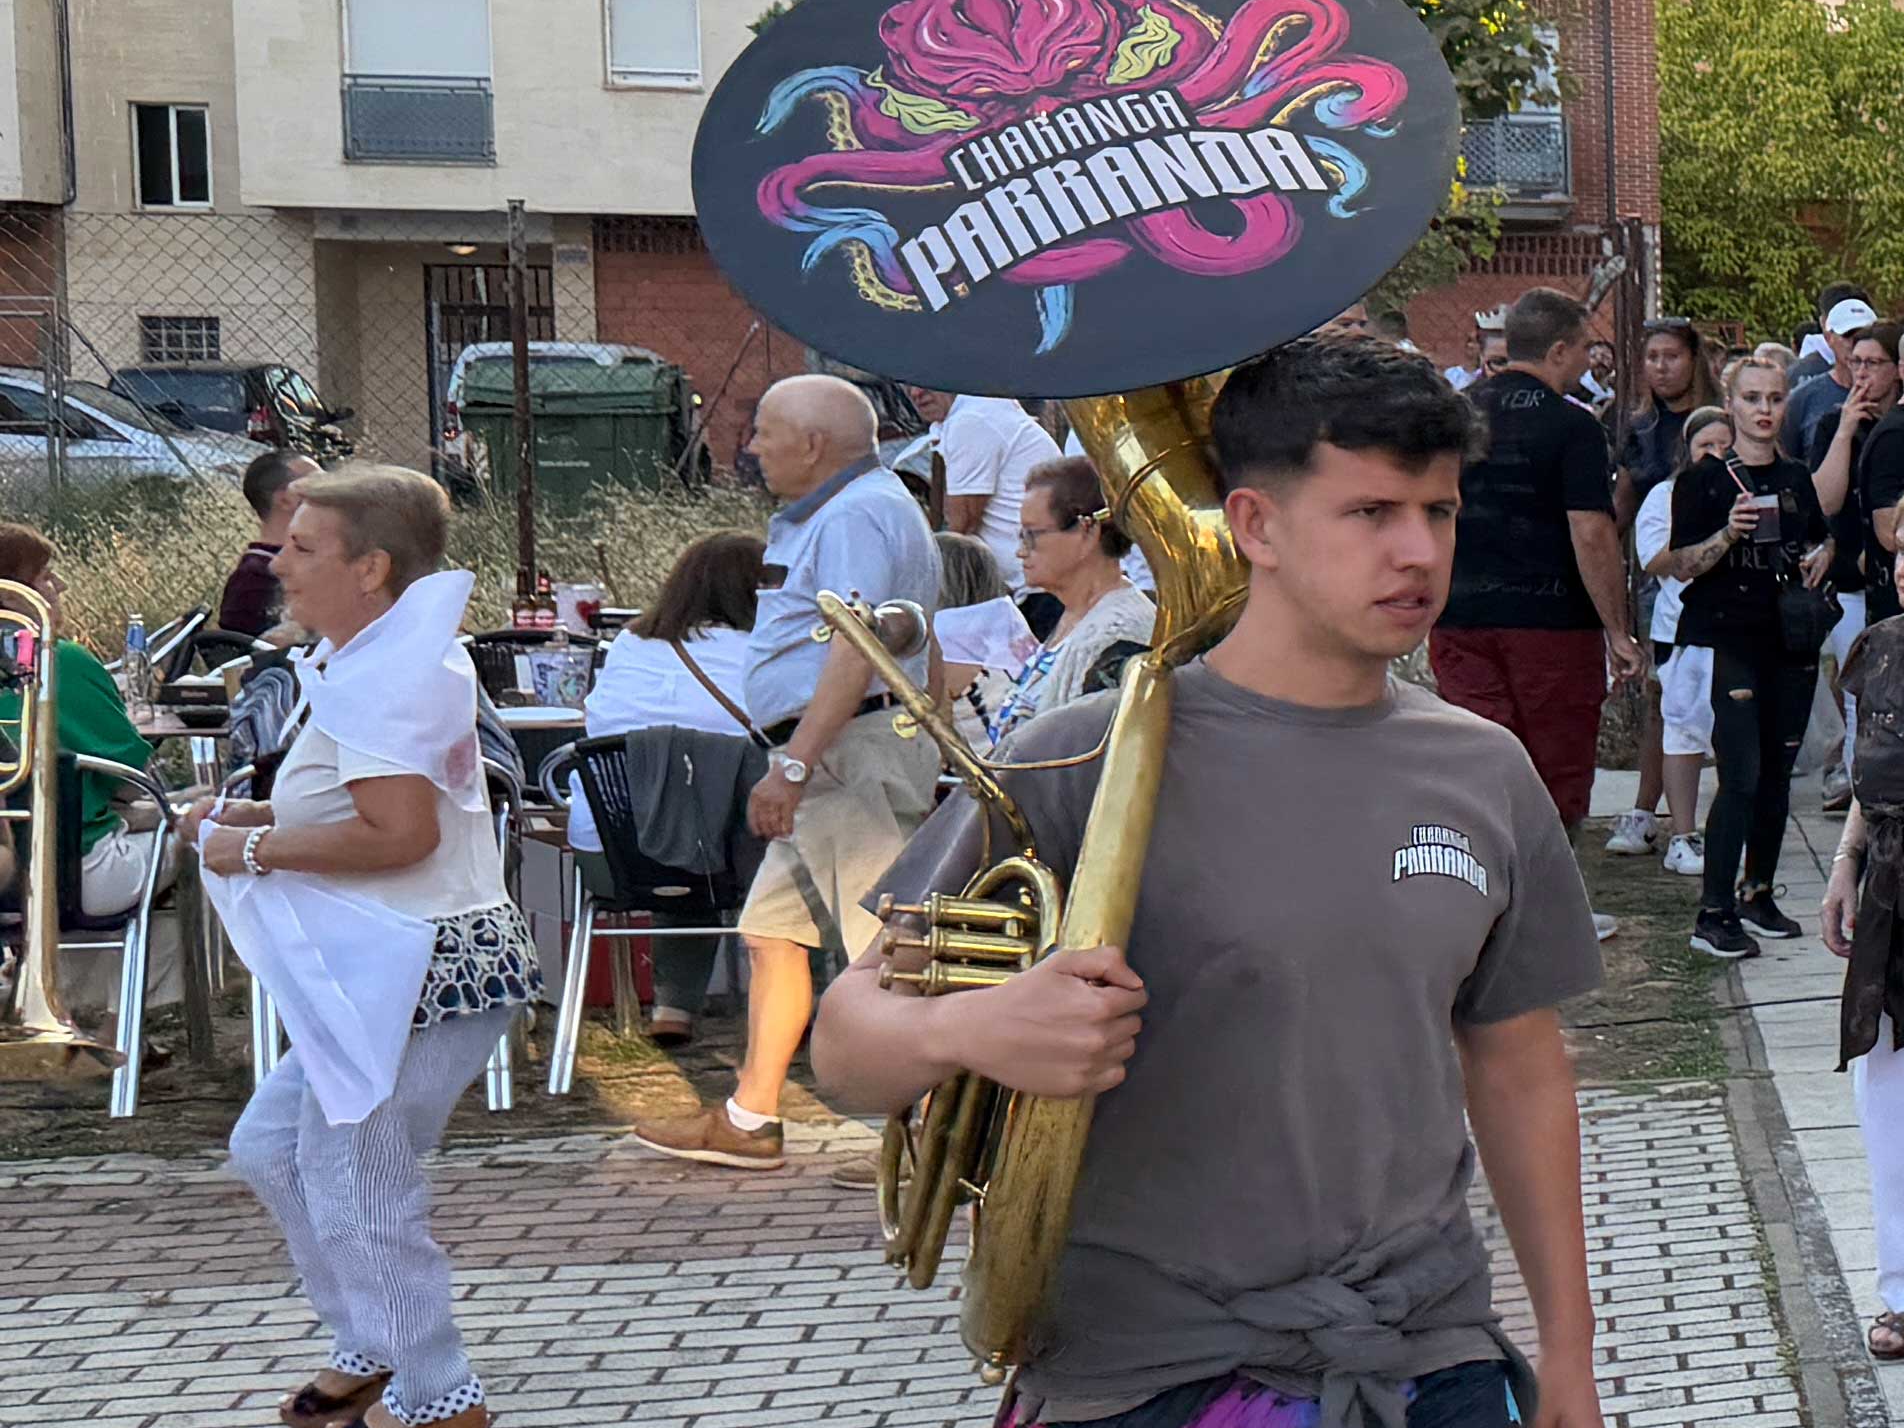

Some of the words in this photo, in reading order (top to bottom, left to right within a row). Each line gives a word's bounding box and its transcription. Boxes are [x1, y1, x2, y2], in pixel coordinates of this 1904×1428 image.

[949, 89, 1190, 191] CHARANGA
[899, 127, 1328, 313] PARRANDA
[1393, 845, 1488, 897] PARRANDA
